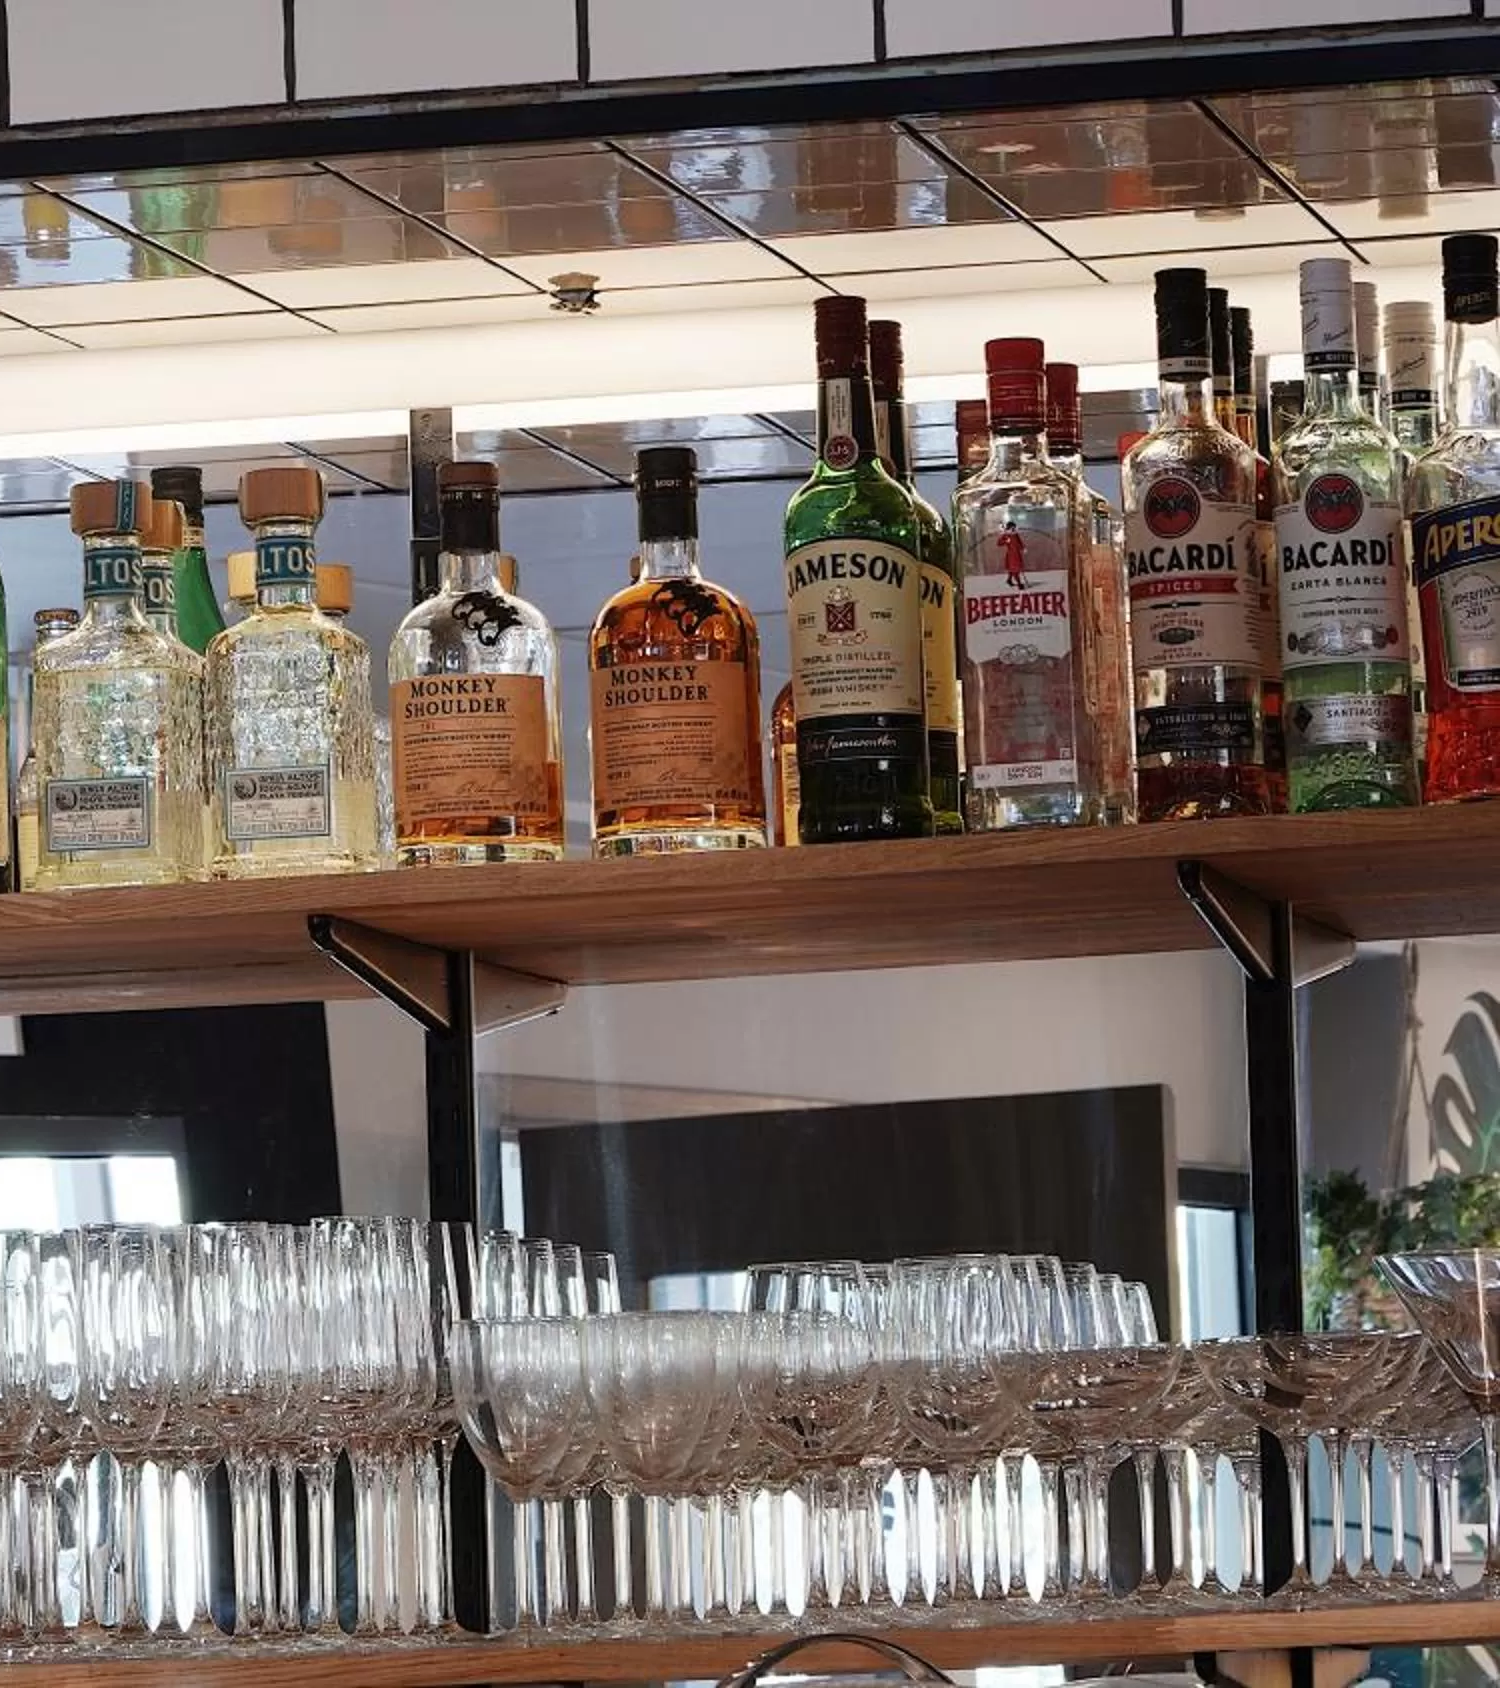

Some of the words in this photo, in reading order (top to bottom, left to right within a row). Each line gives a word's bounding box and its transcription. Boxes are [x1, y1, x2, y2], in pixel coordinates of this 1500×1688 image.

[1128, 536, 1237, 578] BACARDÍ
[1283, 532, 1397, 573] BACARDÍ
[787, 552, 906, 599] JAMESON
[1291, 578, 1330, 590] CARTA
[966, 591, 1067, 625] BEEFEATER
[993, 615, 1043, 627] LONDON
[611, 665, 698, 687] MONKEY
[411, 678, 496, 699] MONKEY
[605, 685, 709, 707] SHOULDER
[405, 698, 508, 719] SHOULDER
